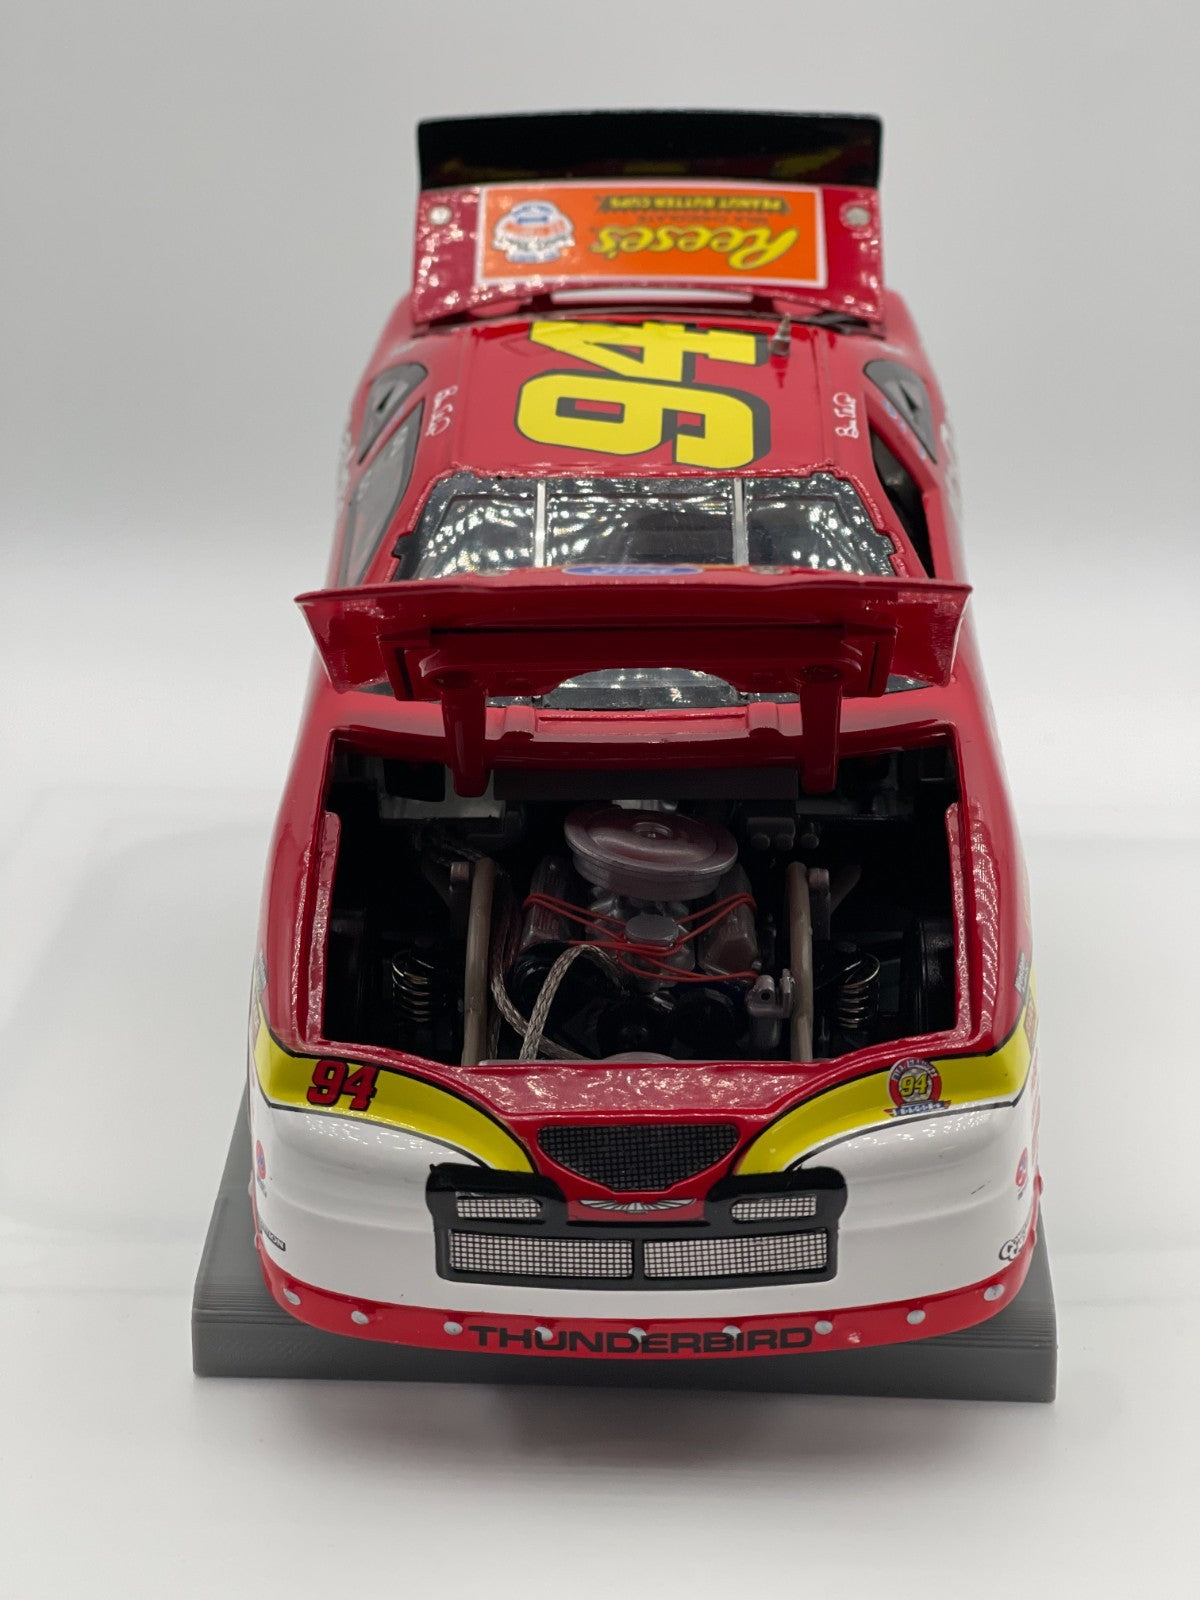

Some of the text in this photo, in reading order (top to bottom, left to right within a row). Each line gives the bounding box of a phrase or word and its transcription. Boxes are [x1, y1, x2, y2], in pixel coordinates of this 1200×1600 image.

[609, 196, 782, 211] PEANUT BUTTER CUPS
[595, 225, 798, 270] Reese's
[515, 320, 771, 469] 94
[306, 1059, 378, 1111] 94
[900, 1074, 928, 1097] 94
[468, 1325, 813, 1354] THUNDERBIRD
